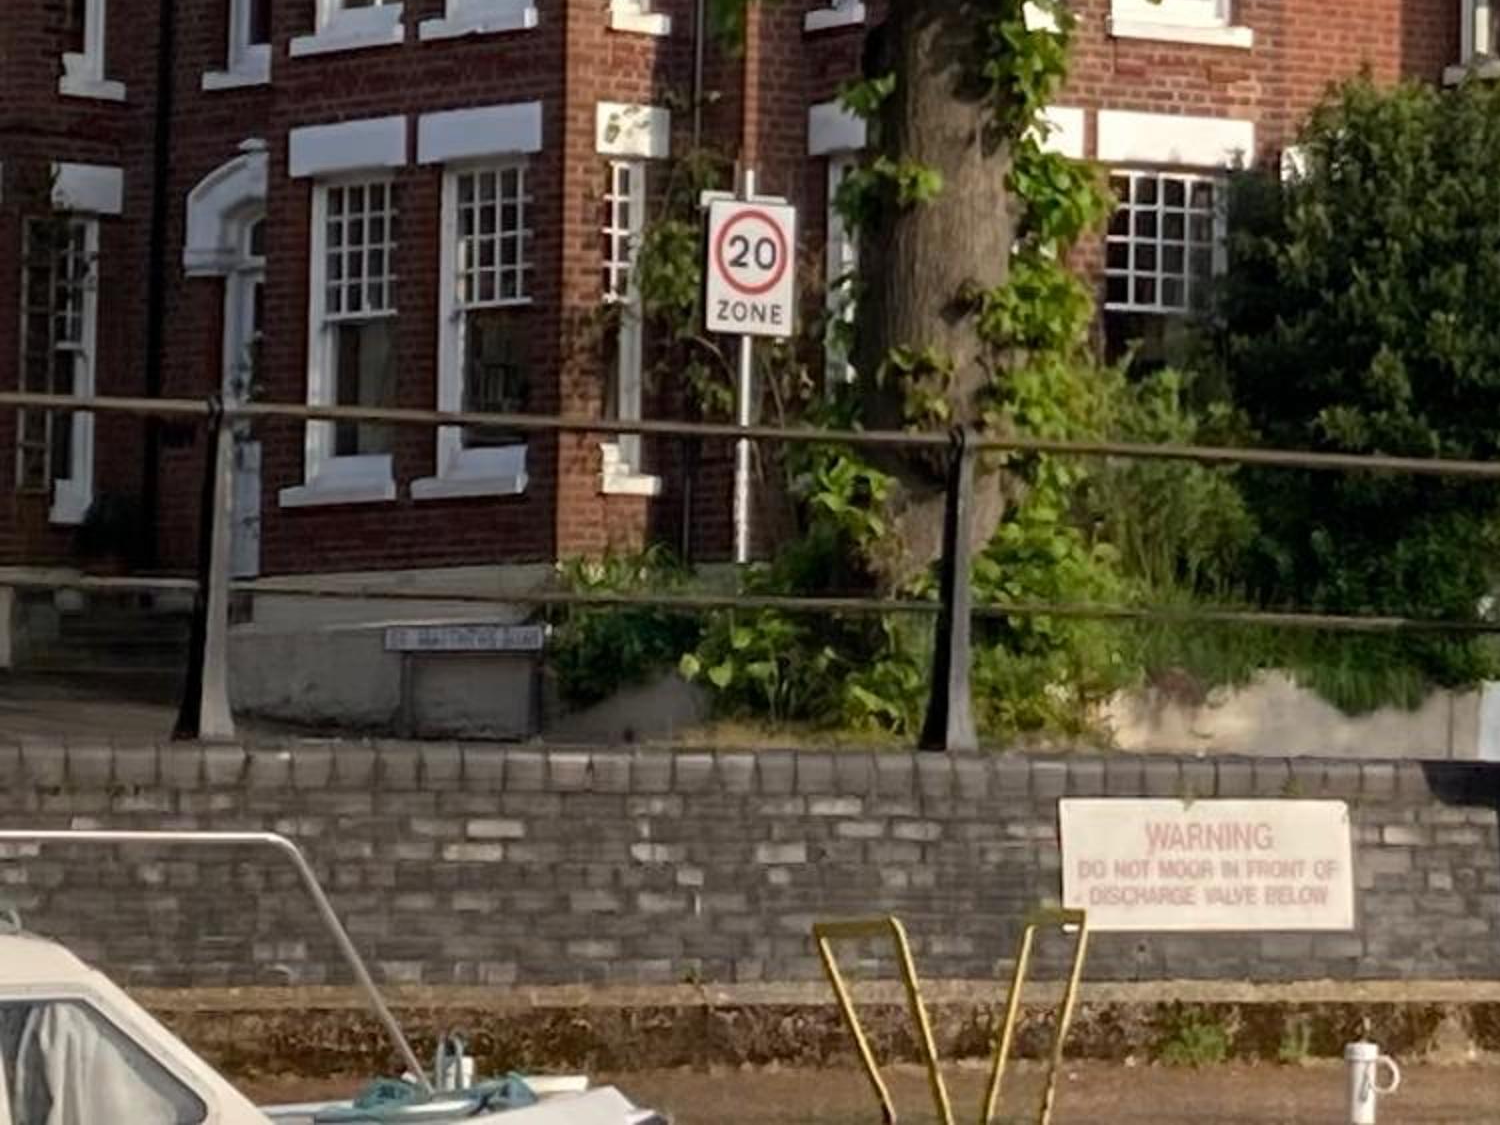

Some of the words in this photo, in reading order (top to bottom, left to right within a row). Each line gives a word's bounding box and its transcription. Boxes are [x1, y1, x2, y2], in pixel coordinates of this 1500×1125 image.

[729, 235, 777, 270] 20
[717, 300, 782, 325] ZONE
[1146, 822, 1273, 851] WARNING
[1077, 860, 1105, 879] DO
[1114, 860, 1151, 879] NOT
[1157, 860, 1214, 879] MOOR
[1221, 860, 1238, 879] IN
[1246, 860, 1305, 879] FRONT
[1313, 860, 1339, 879] OF
[1090, 886, 1196, 906] DISCHARGE
[1203, 886, 1257, 906] VALVE
[1265, 886, 1328, 906] BELOW
